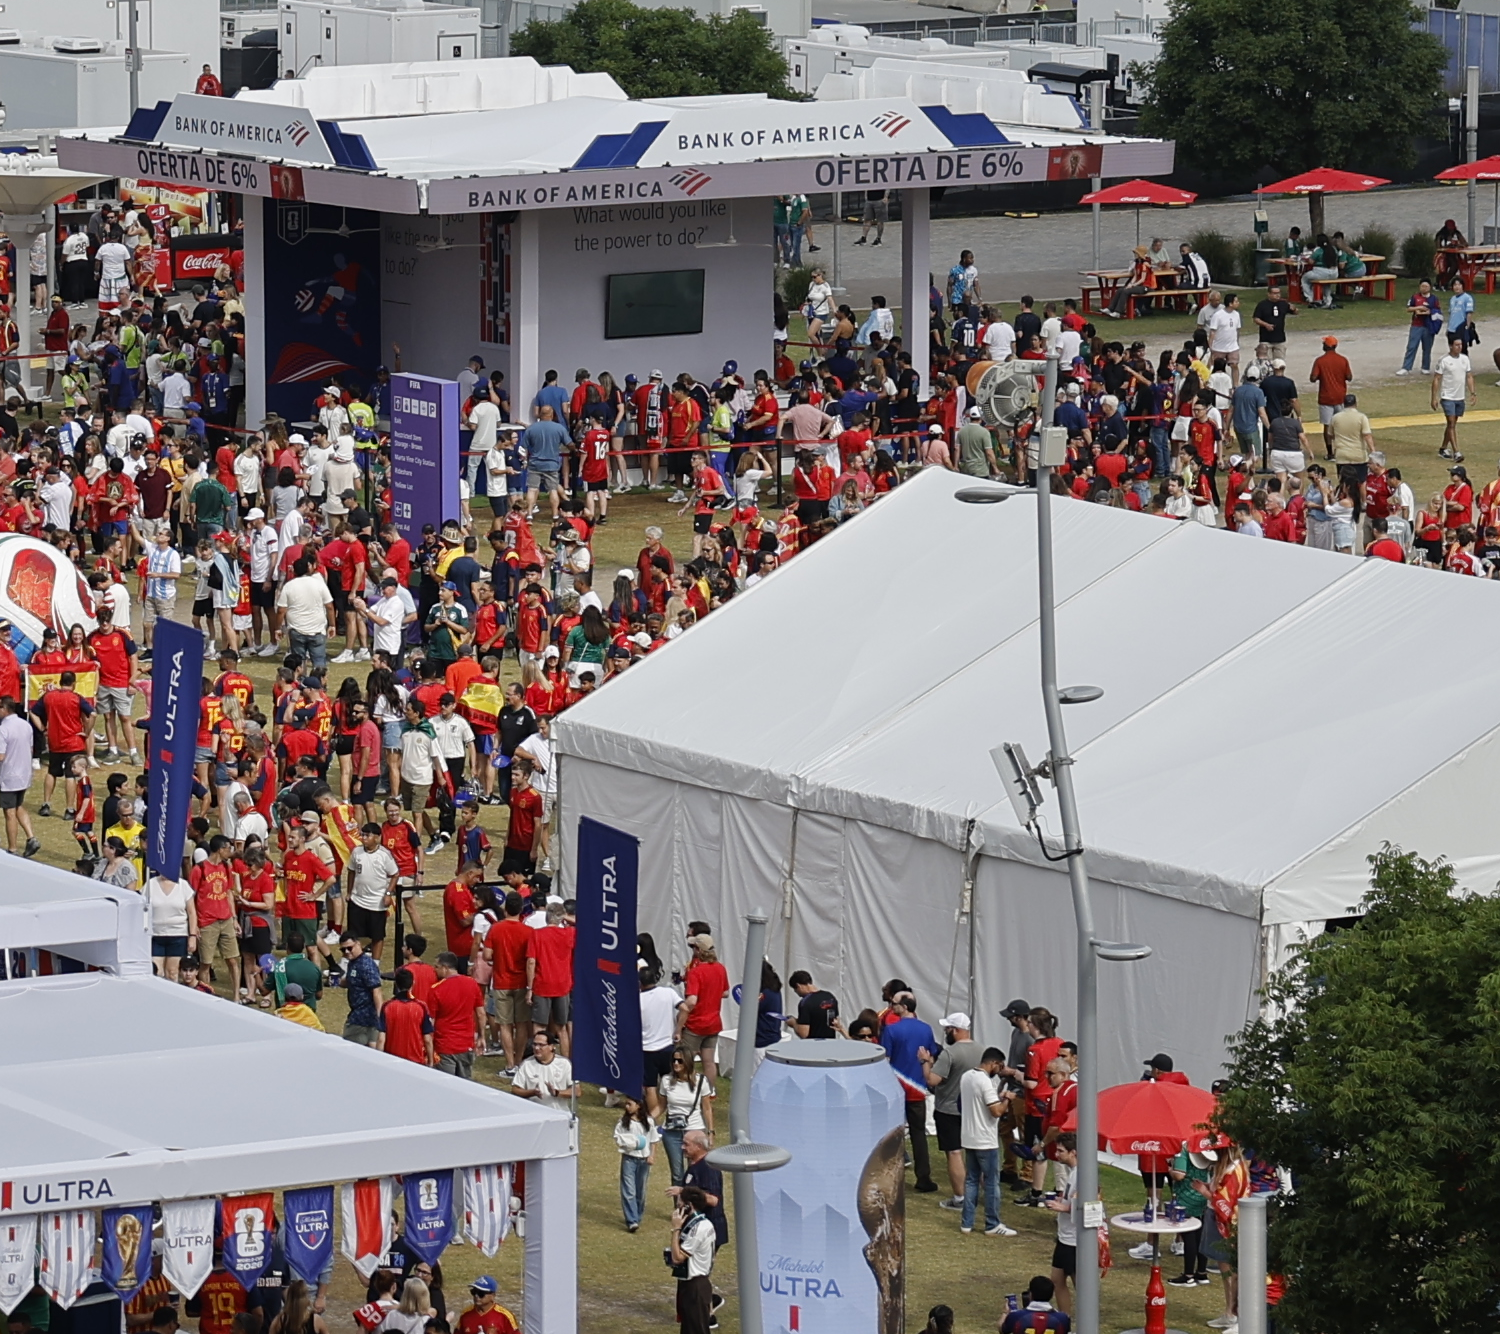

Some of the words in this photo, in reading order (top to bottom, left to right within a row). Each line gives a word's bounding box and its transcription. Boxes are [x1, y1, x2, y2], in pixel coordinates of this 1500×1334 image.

[175, 116, 207, 136] BANK
[208, 120, 225, 138] OF
[226, 122, 283, 145] AMERICA
[678, 132, 734, 150] BANK
[740, 129, 767, 147] OF
[772, 124, 865, 144] AMERICA
[136, 149, 203, 185] OFERTA
[202, 157, 228, 186] DE
[229, 162, 258, 190] 6%
[814, 156, 928, 188] OFERTA
[935, 153, 971, 180] DE
[980, 151, 1024, 178] 6%
[468, 187, 526, 208] BANK
[532, 185, 562, 205] OF
[563, 180, 663, 203] AMERICA
[573, 203, 611, 224] What
[618, 201, 664, 222] would
[668, 202, 695, 224] you
[701, 198, 726, 217] like
[574, 233, 600, 251] the
[603, 234, 651, 254] power
[656, 230, 673, 245] to
[182, 253, 224, 271] Coca-Cola
[409, 380, 421, 390] FIFA
[164, 649, 184, 742] ULTRA
[602, 854, 619, 951] ULTRA
[22, 1178, 115, 1205] ULTRA
[295, 1221, 330, 1233] ULTRA
[417, 1220, 446, 1231] ULTRA
[167, 1234, 212, 1248] ULTRA
[766, 1253, 824, 1274] Michelob
[760, 1271, 842, 1298] ULTRA
